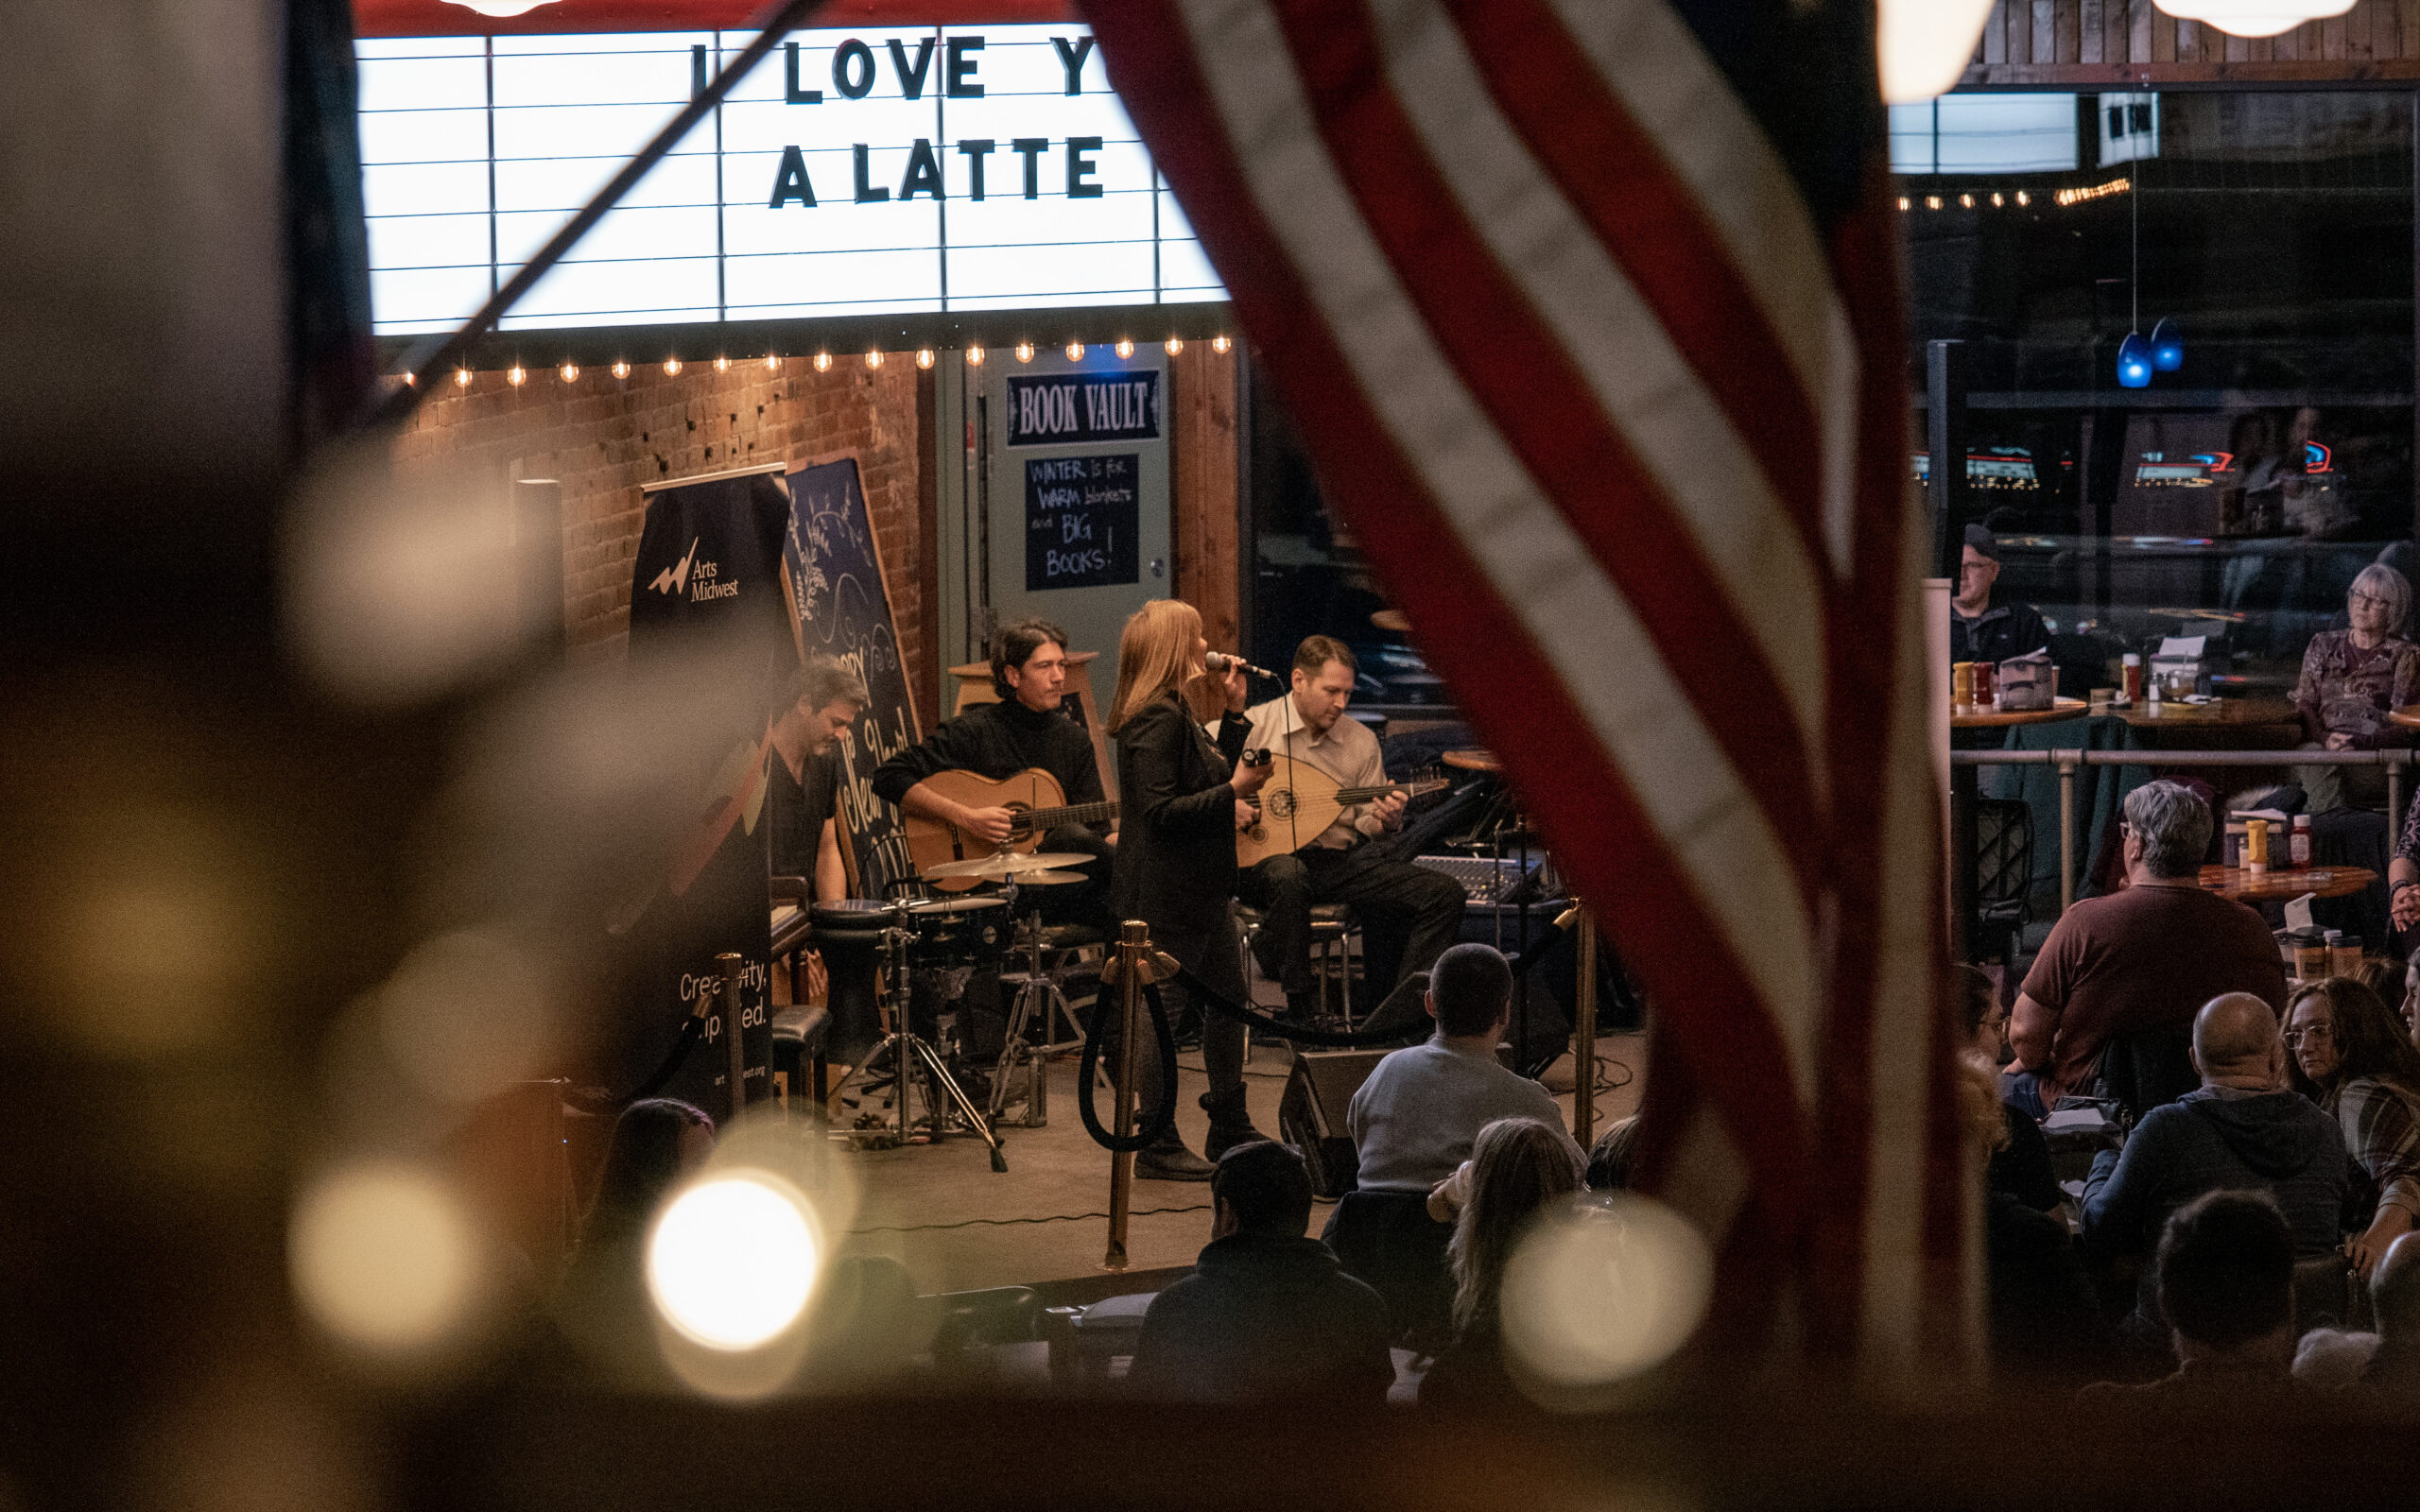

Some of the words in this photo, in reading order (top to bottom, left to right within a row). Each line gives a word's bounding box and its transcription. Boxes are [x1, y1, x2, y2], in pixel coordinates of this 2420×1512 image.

[690, 44, 707, 103] I
[784, 36, 985, 105] LOVE
[769, 145, 818, 209] A
[853, 136, 1103, 204] LATTE
[1019, 384, 1079, 435] BOOK
[1084, 382, 1148, 431] VAULT
[1029, 459, 1087, 485] WINTER
[1037, 487, 1081, 510] WARM
[1062, 513, 1093, 544] BIG
[692, 559, 717, 580] Arts
[691, 578, 739, 603] Midwest
[681, 960, 767, 1002] Creaity,
[715, 1066, 766, 1086] artest.org
